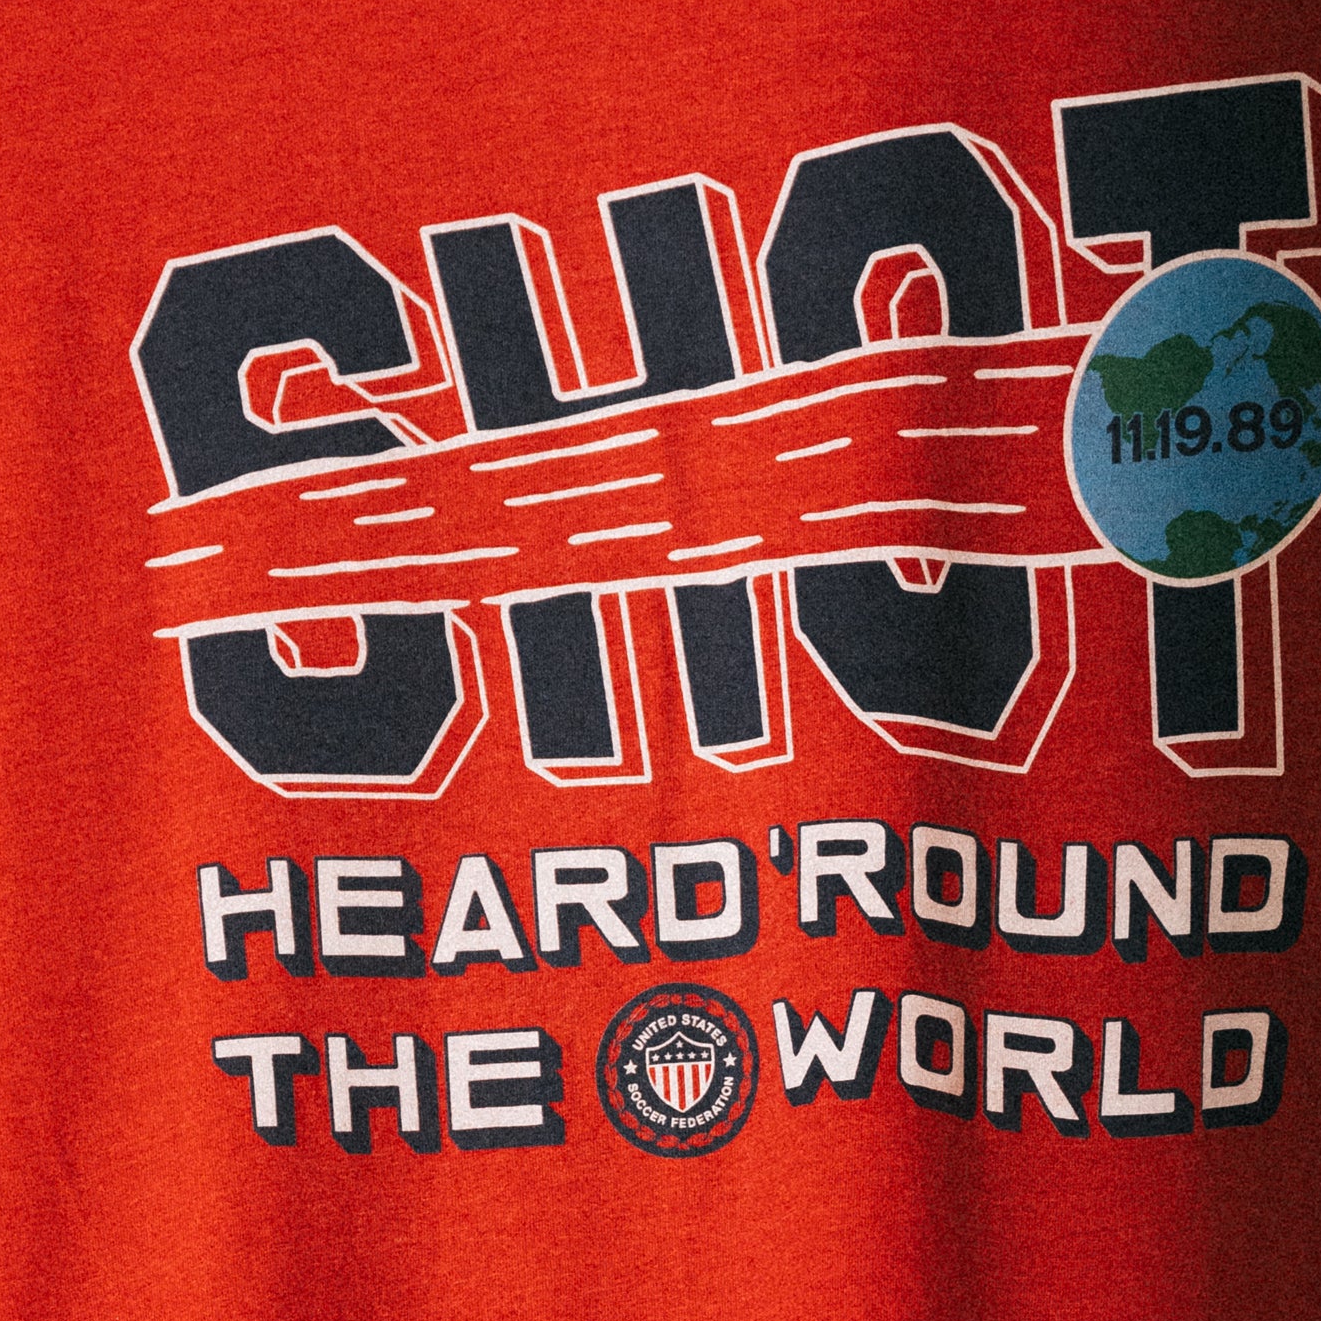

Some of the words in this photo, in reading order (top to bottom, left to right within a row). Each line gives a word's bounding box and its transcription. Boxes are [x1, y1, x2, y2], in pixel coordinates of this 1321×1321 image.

[1106, 398, 1305, 464] 11.19.89
[196, 839, 763, 980] HEARD
[632, 1014, 677, 1052] UNITED
[681, 1013, 728, 1047] STATES
[214, 1029, 566, 1154] THE
[772, 989, 1288, 1140] WORLD
[627, 1082, 667, 1125] SOCCER
[670, 1075, 734, 1129] FEDERATION
